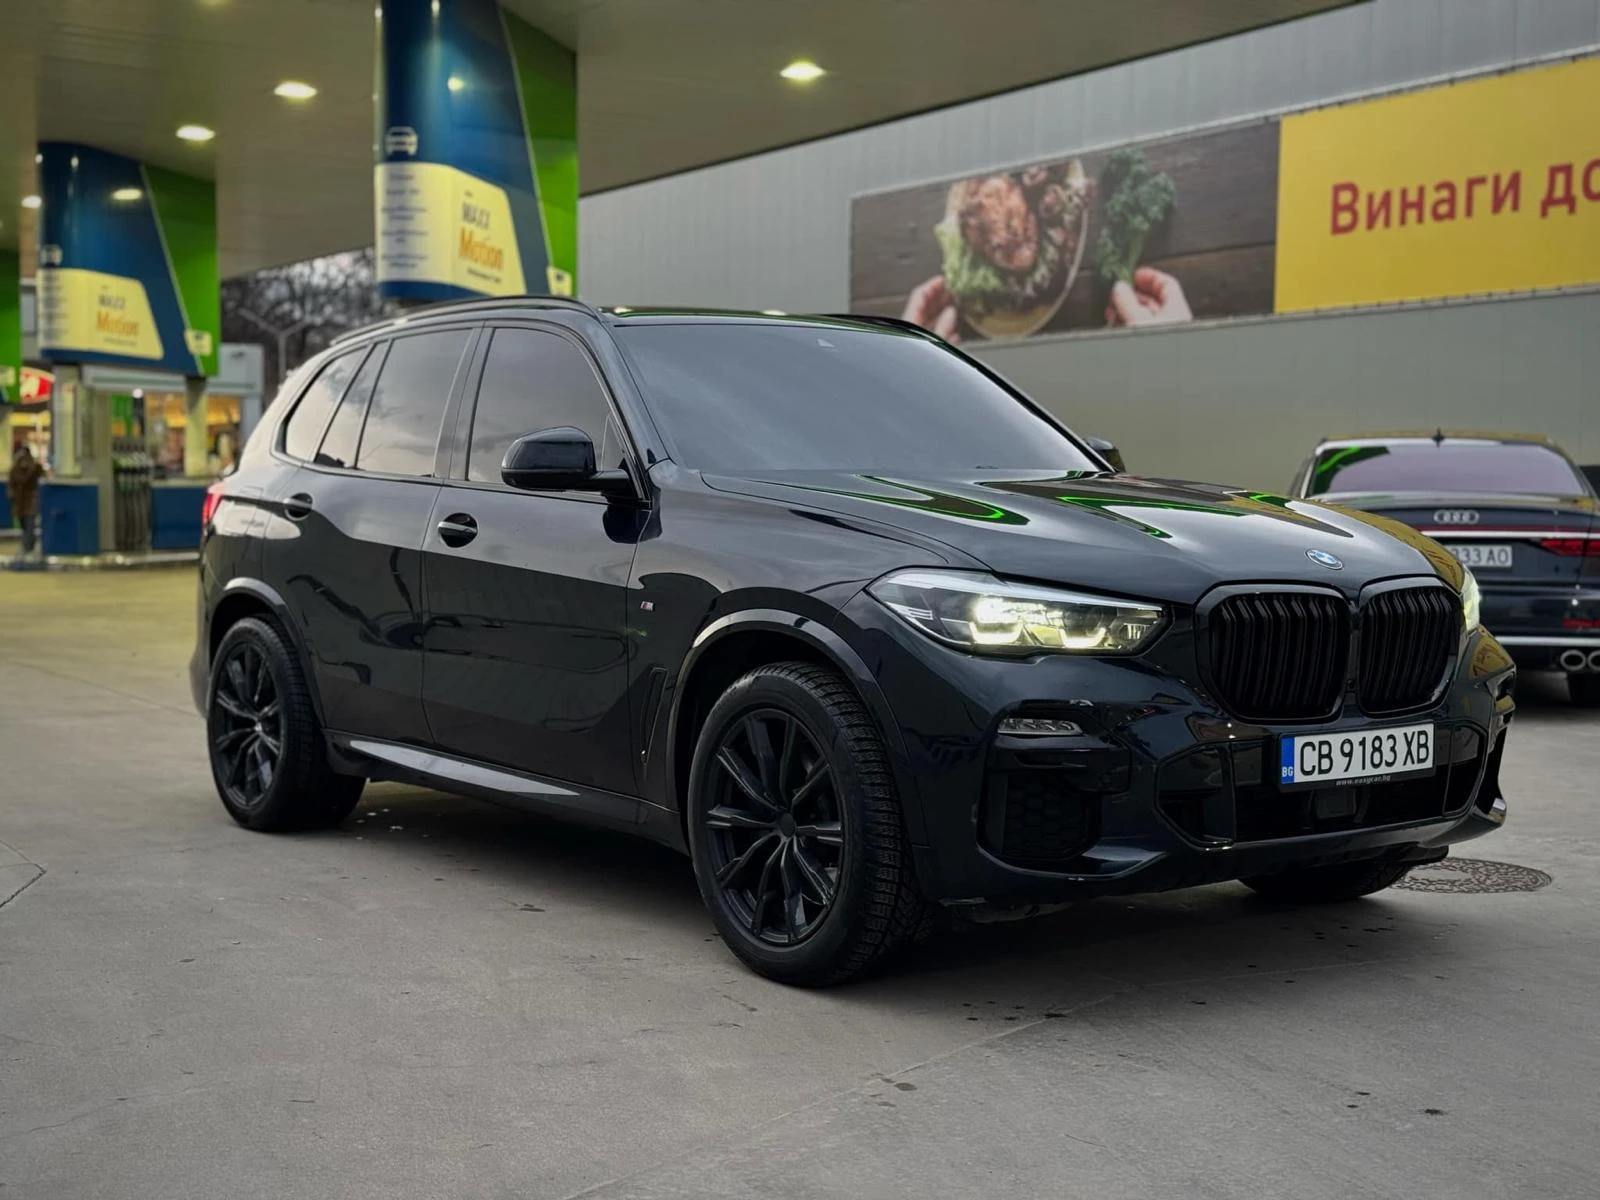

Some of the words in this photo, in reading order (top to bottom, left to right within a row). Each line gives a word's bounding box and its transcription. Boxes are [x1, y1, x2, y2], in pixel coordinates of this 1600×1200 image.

[1330, 169, 1522, 236] Винаги
[1282, 766, 1293, 777] BG
[1300, 740, 1334, 776] CB
[1340, 734, 1398, 773] 9183
[1402, 730, 1430, 766] XB
